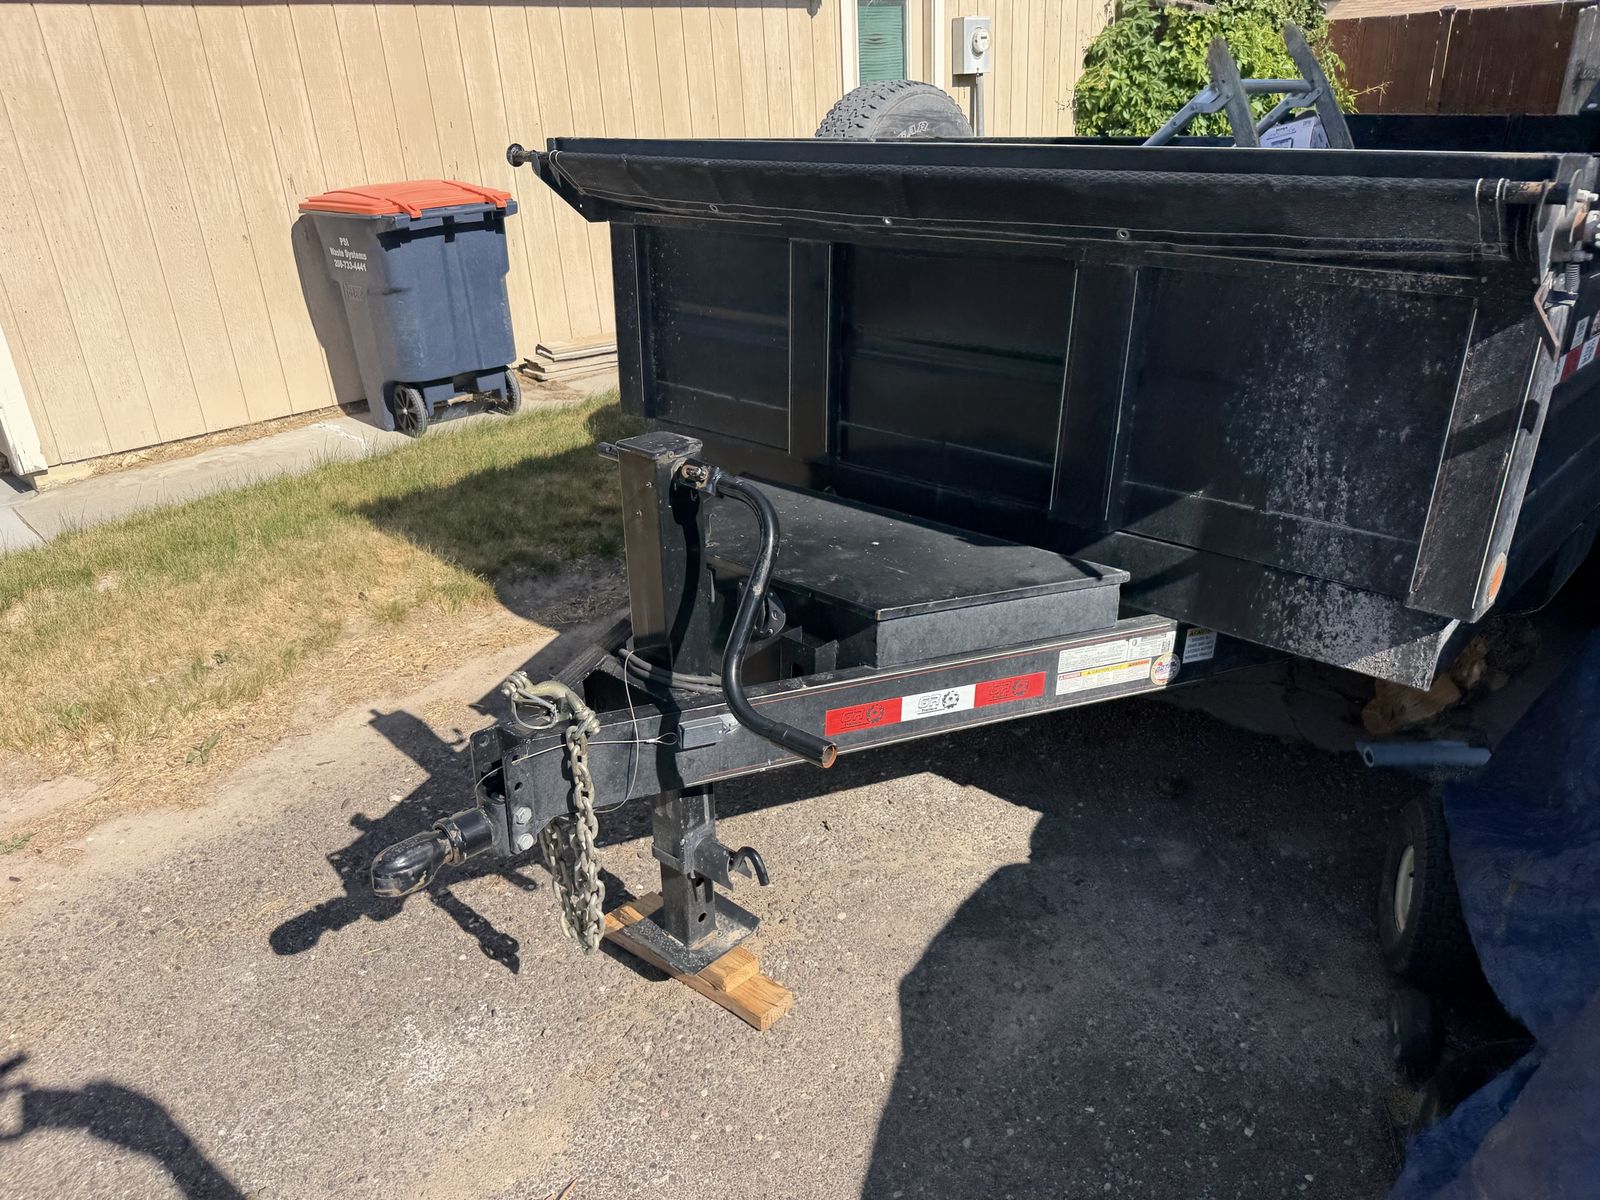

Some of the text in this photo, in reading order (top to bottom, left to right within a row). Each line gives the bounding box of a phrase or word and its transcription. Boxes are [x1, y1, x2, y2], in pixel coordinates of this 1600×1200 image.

[339, 236, 350, 246] PSI
[329, 247, 367, 260] Waste Systems
[918, 694, 940, 709] GR
